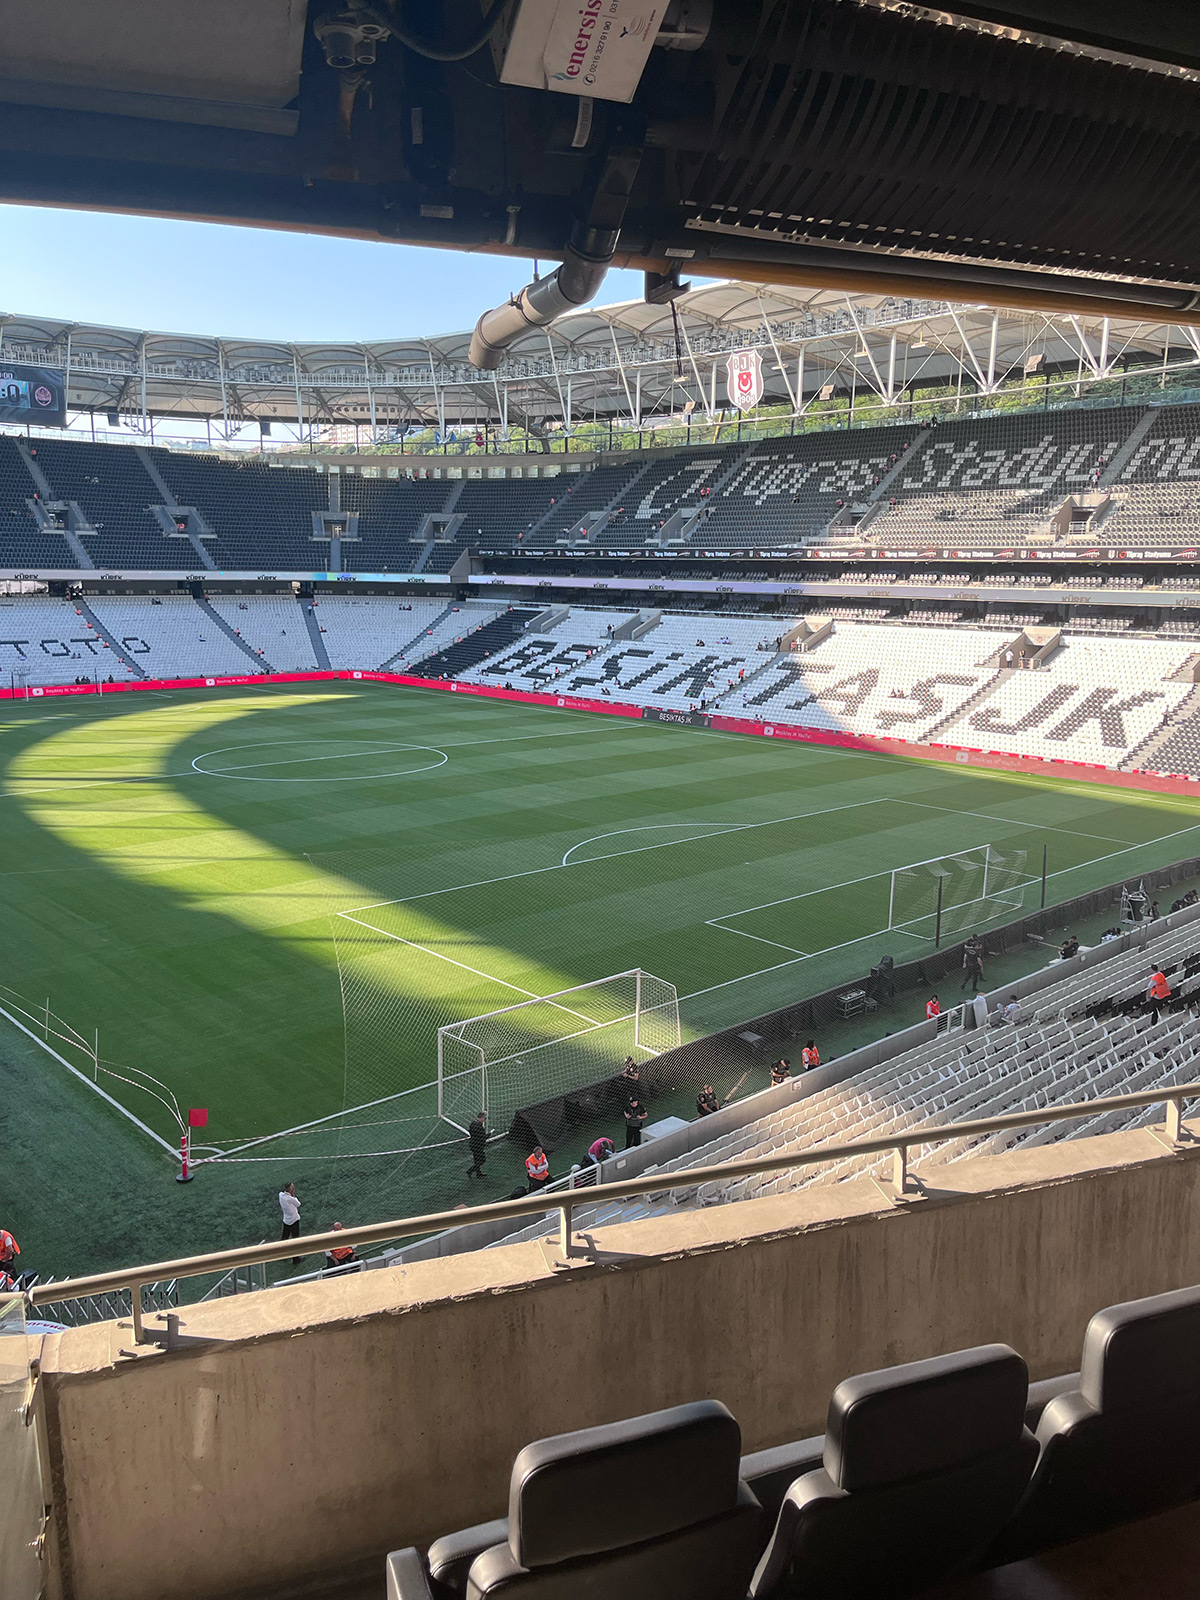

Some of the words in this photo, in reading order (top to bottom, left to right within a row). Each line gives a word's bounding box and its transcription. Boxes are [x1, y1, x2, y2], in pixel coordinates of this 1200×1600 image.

[566, 0, 602, 76] enersis
[733, 355, 755, 370] BJK
[737, 394, 756, 404] 1903
[969, 683, 1166, 749] JK
